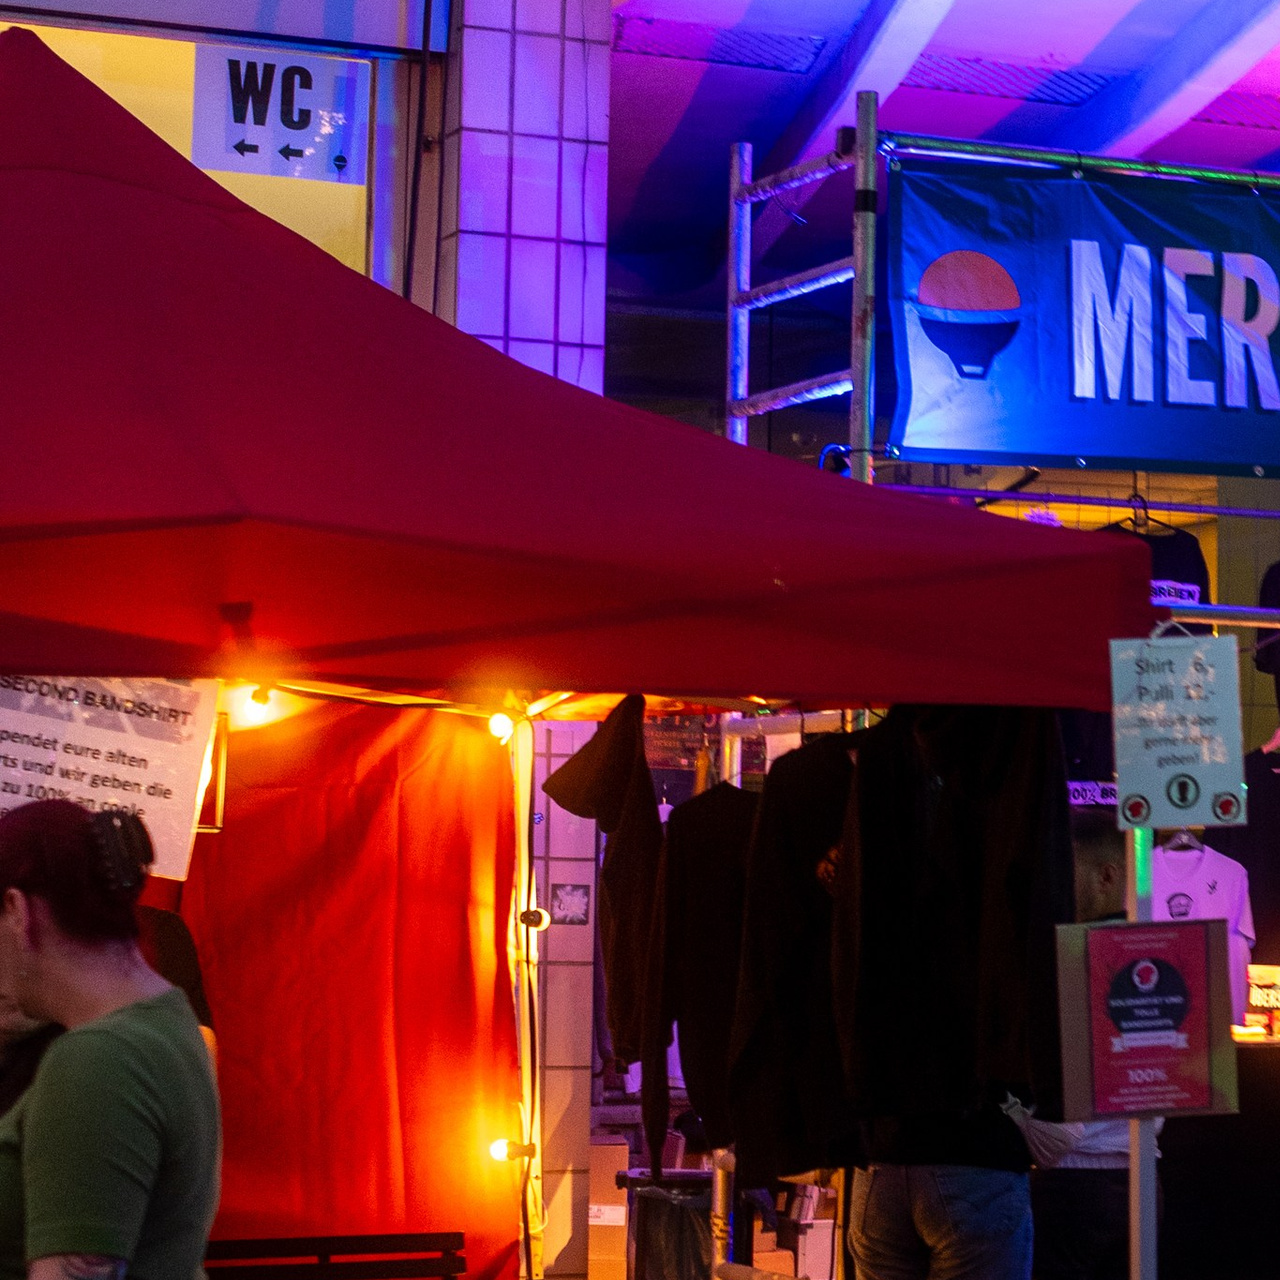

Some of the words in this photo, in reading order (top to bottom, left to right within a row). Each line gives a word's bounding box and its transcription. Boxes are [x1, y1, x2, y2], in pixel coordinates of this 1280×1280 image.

[227, 58, 313, 131] WC
[1134, 657, 1175, 676] Shirt
[0, 675, 79, 703] SECOND
[1137, 684, 1175, 702] Pulli
[0, 729, 59, 752] pendet
[62, 742, 101, 760] eure
[104, 748, 149, 770] alten
[2, 780, 20, 795] zu
[22, 758, 55, 776] und
[59, 767, 88, 782] wir
[90, 773, 142, 792] geben
[146, 781, 174, 800] die
[1070, 786, 1097, 801] 00%
[1127, 1068, 1168, 1083] 100%
